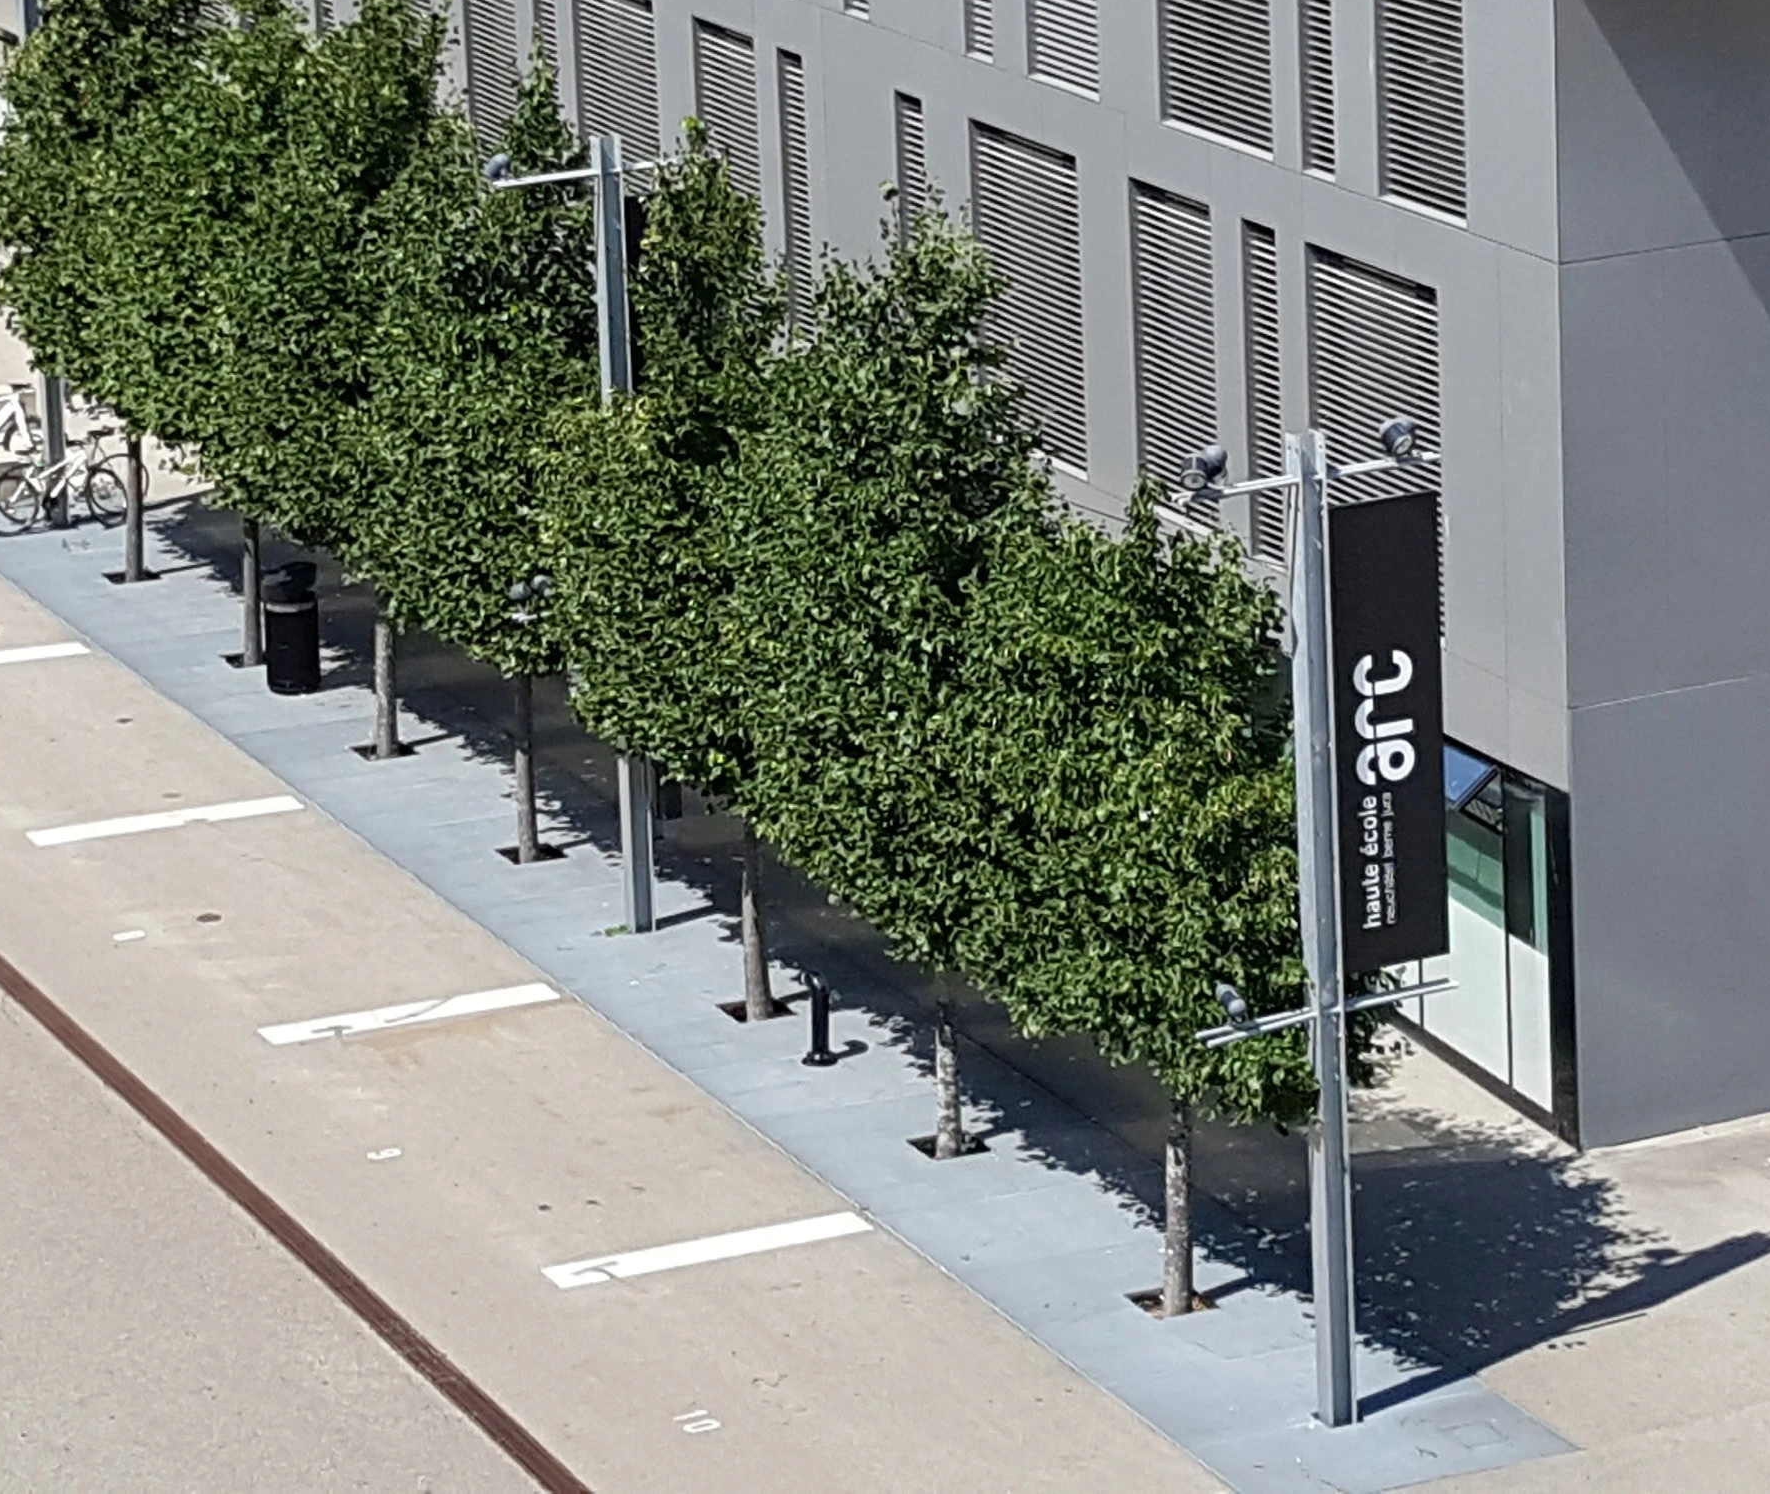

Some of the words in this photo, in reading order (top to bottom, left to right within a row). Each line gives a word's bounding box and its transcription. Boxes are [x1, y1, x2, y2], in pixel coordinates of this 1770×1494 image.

[1353, 650, 1415, 785] arc
[1358, 795, 1378, 856] école
[1361, 863, 1382, 929] haute
[672, 1410, 720, 1433] 10
